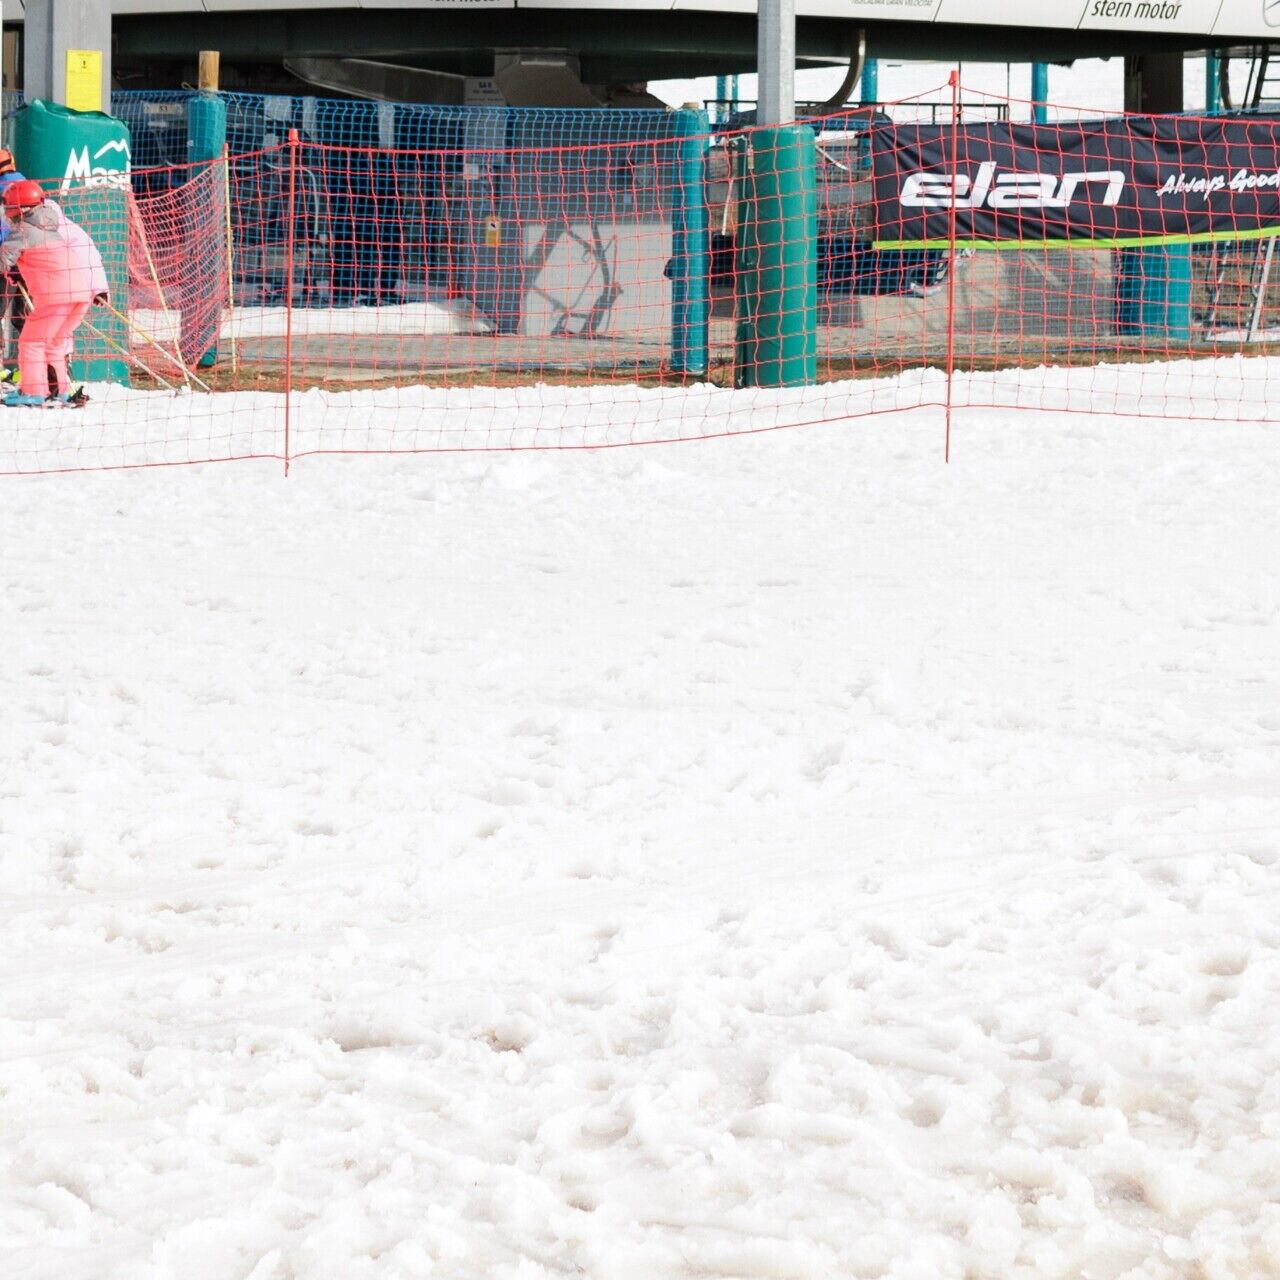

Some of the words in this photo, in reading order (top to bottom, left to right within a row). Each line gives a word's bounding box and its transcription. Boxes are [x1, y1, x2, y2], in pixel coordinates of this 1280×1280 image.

[1134, 1, 1182, 21] motor
[899, 161, 1125, 209] elan
[1156, 172, 1226, 201] Always
